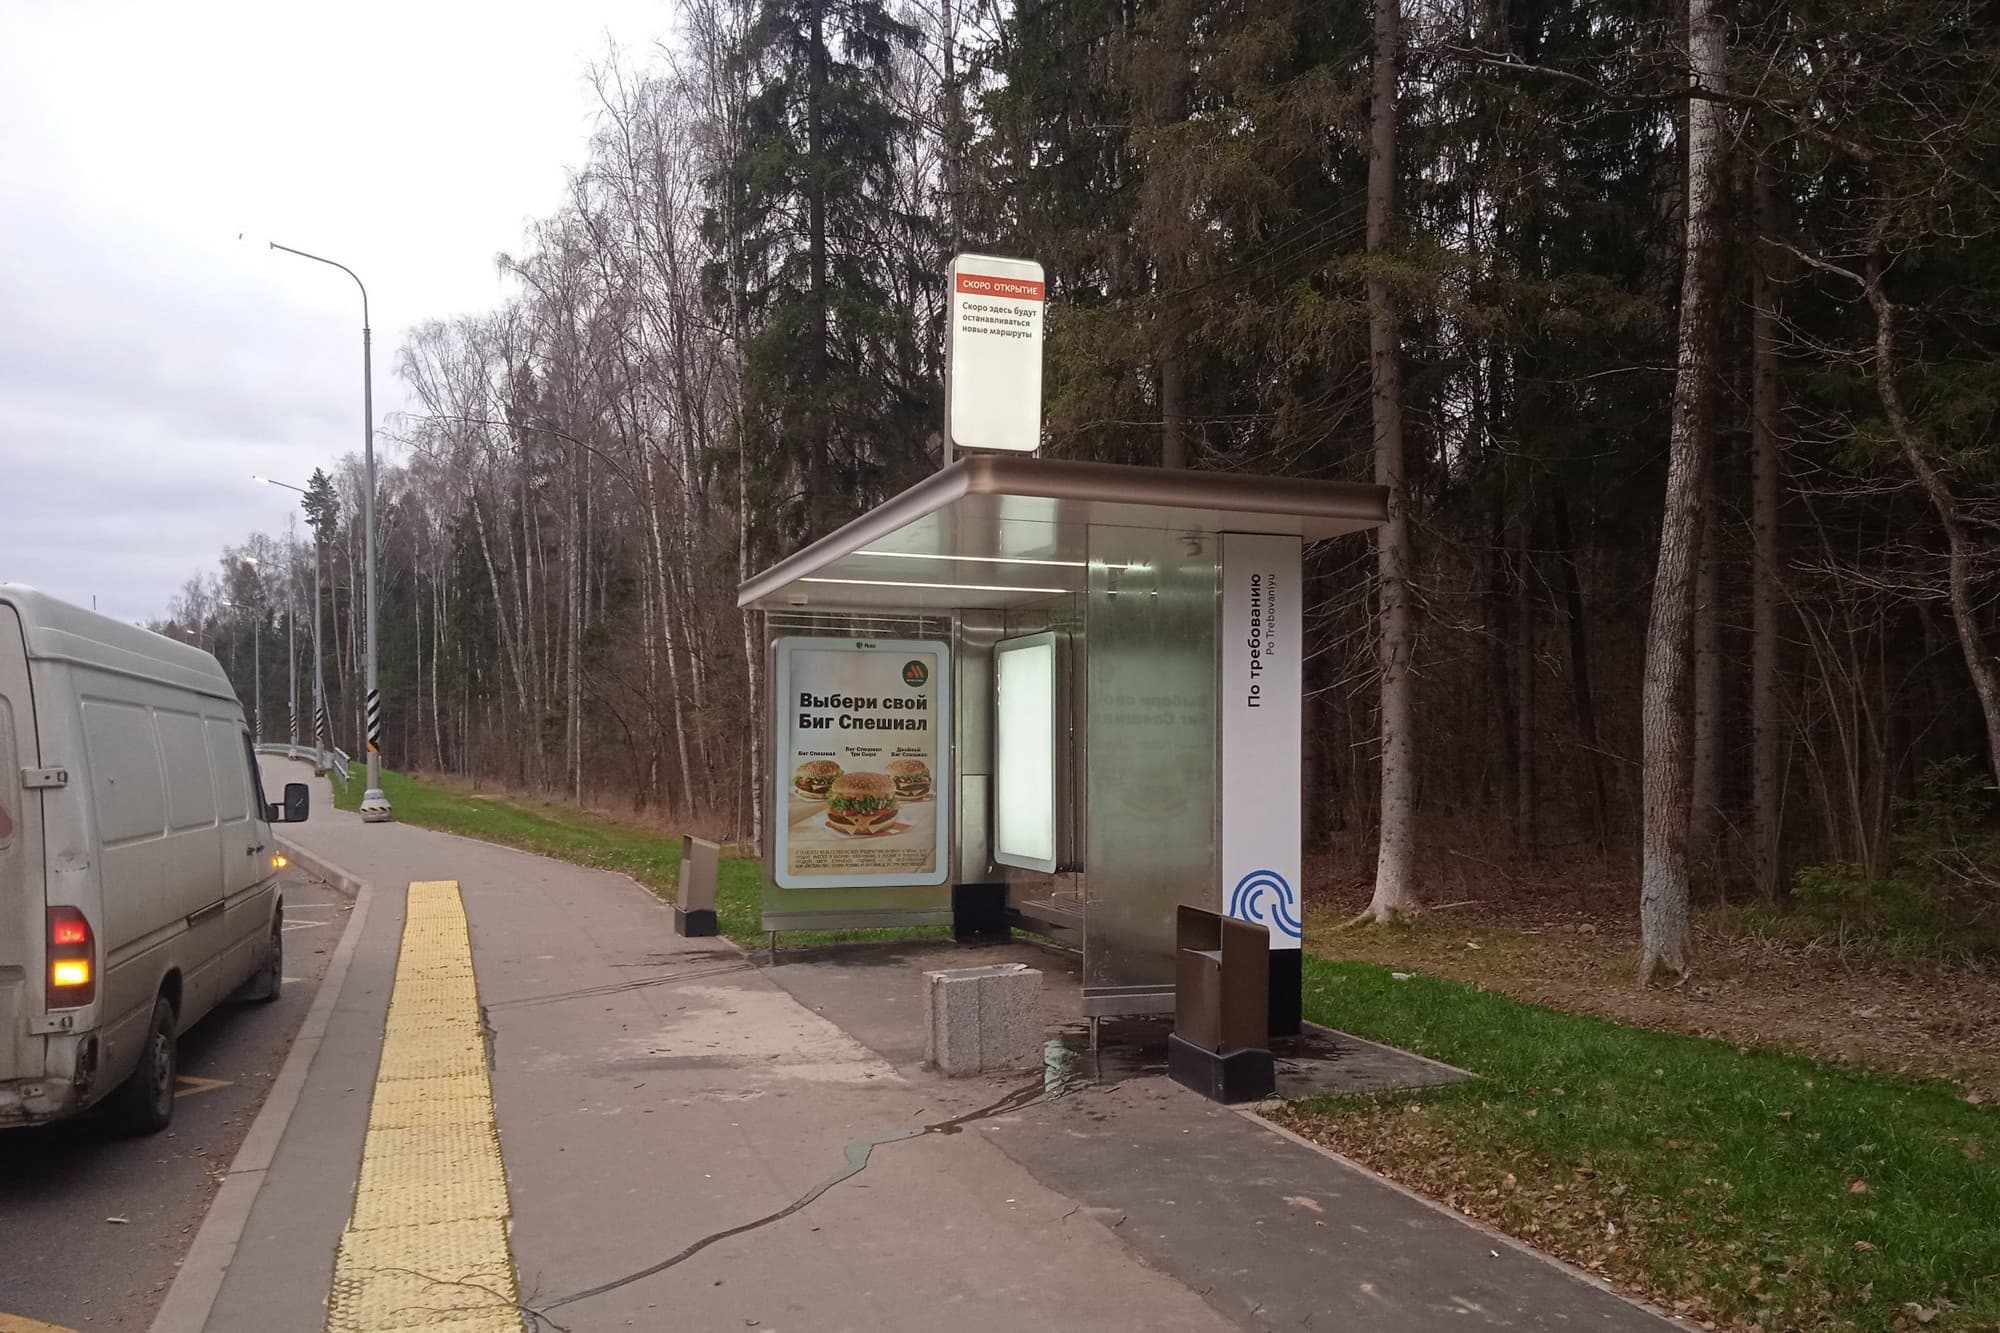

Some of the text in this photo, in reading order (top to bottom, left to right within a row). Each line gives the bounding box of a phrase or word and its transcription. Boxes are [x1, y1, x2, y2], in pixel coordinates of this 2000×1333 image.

[962, 279, 1039, 295] СКОРО ОТКРЫТИЕ
[962, 301, 1037, 318] Скоро здесь будут
[962, 315, 1030, 327] останавливаться
[962, 325, 1032, 339] новые маршруты
[1265, 573, 1276, 655] Po Trebovaniyu
[1247, 573, 1263, 707] По требованию
[800, 692, 928, 712] Выбери свой
[799, 713, 928, 731] Биг Спешиал
